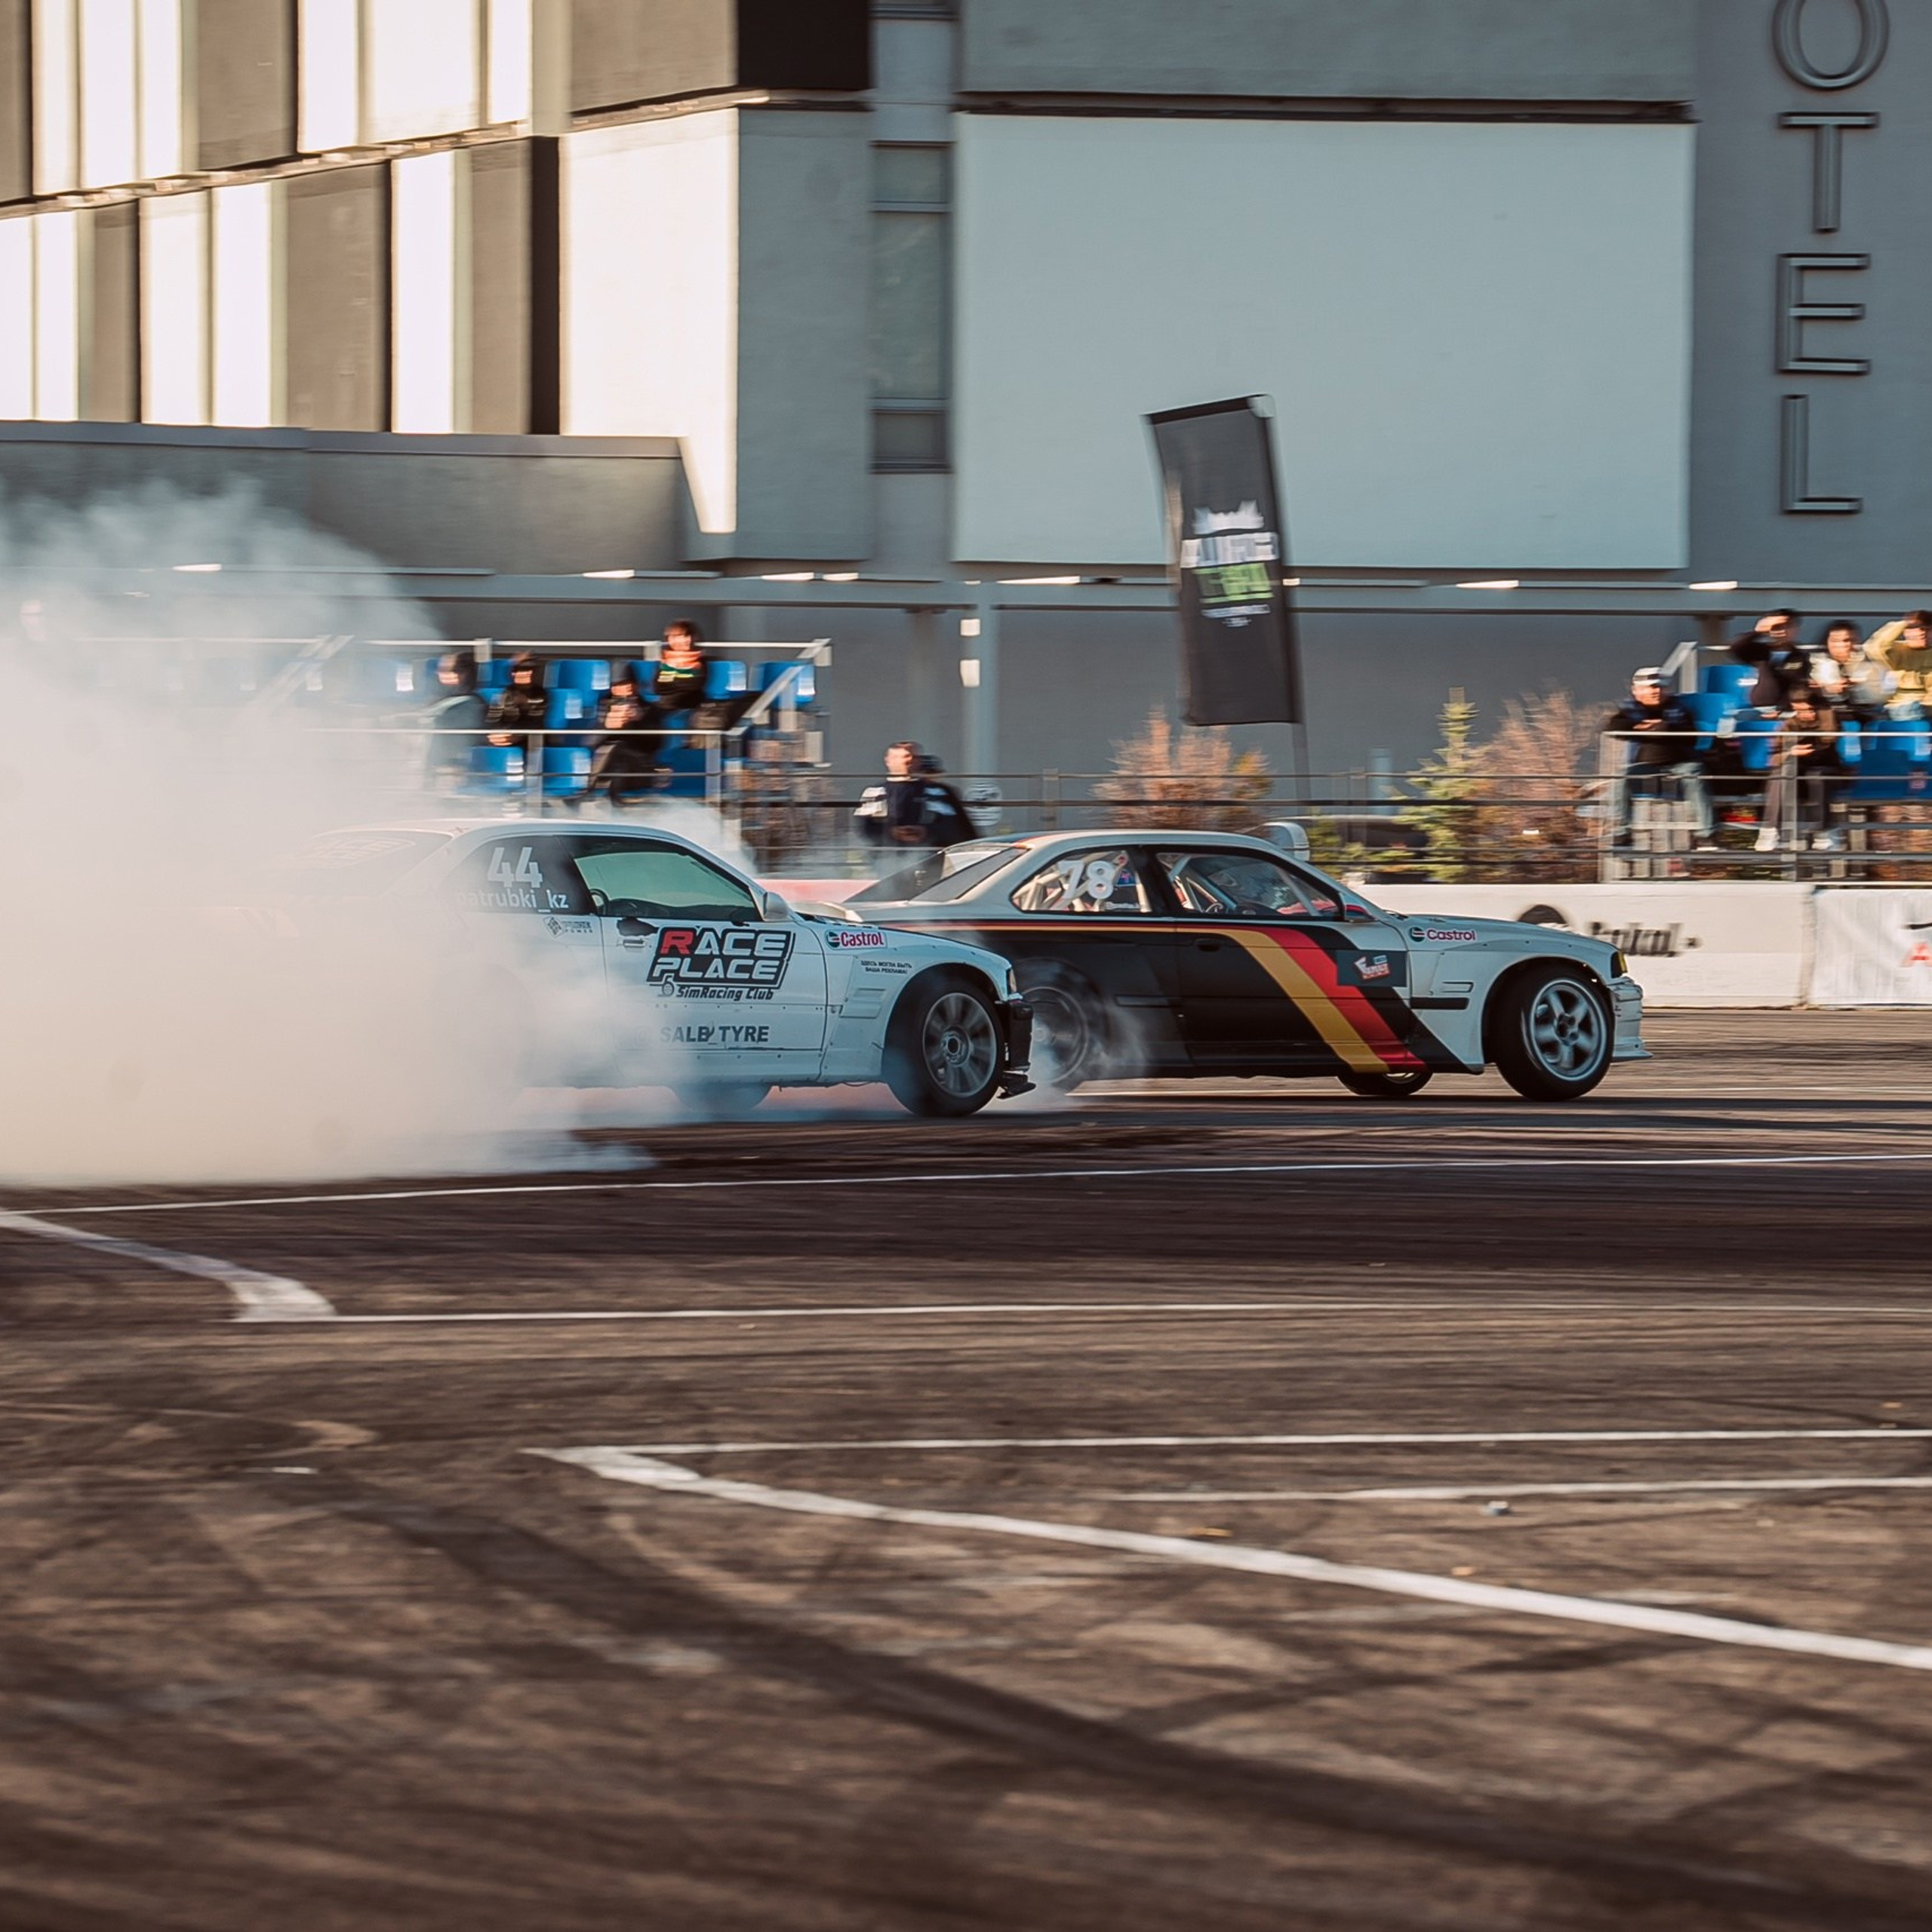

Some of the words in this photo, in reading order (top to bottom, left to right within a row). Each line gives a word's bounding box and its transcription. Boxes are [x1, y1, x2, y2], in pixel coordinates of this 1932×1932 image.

[488, 846, 543, 888] 44
[1057, 860, 1115, 900] 78
[659, 930, 787, 957] RACE
[841, 931, 884, 946] Castrol
[1426, 929, 1475, 941] Castrol
[652, 957, 780, 980] PLACE
[676, 986, 743, 1001] SimRacing
[746, 988, 774, 1001] Club
